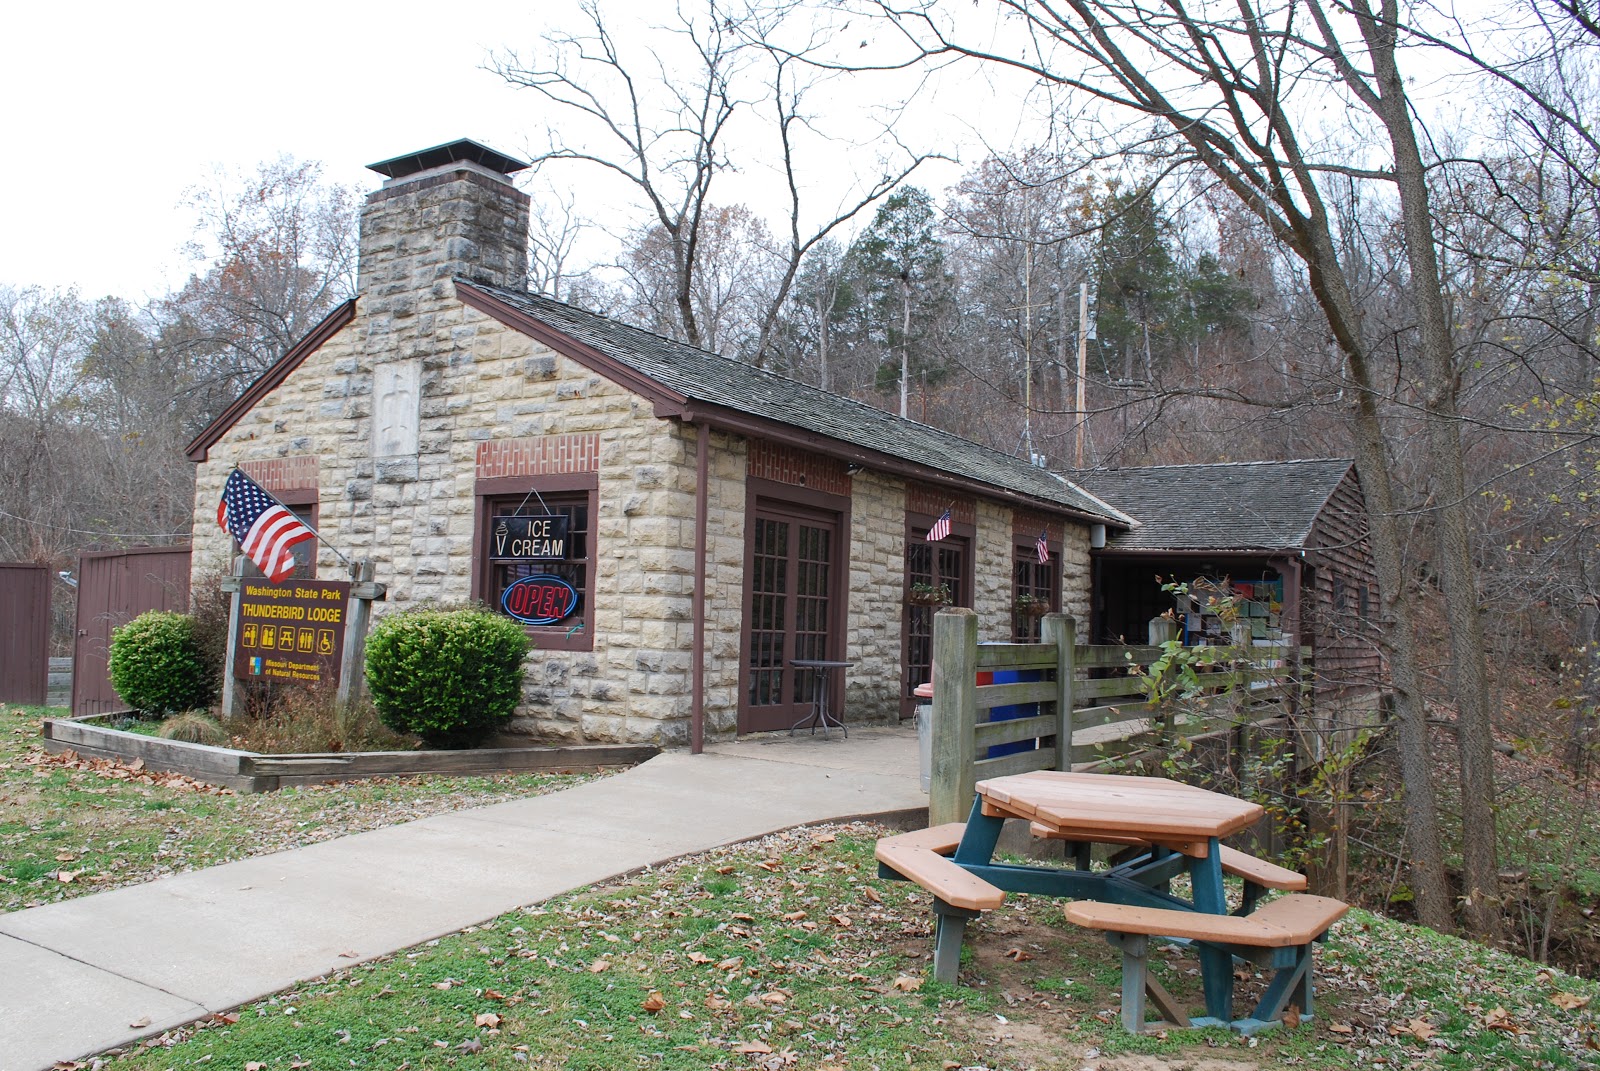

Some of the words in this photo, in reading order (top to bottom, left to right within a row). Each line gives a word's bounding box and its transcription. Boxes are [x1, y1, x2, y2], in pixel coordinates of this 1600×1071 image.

[527, 520, 551, 537] ICE
[511, 539, 564, 556] CREAM
[246, 585, 292, 599] Washington
[295, 587, 318, 599] State
[321, 589, 341, 600] Park
[509, 583, 569, 619] OPEN
[242, 603, 304, 620] THUNDERBIRD
[307, 607, 341, 623] LODGE
[265, 659, 287, 669] Missouri
[288, 661, 320, 672] Department
[272, 669, 291, 678] Natural
[292, 671, 320, 680] Resources
